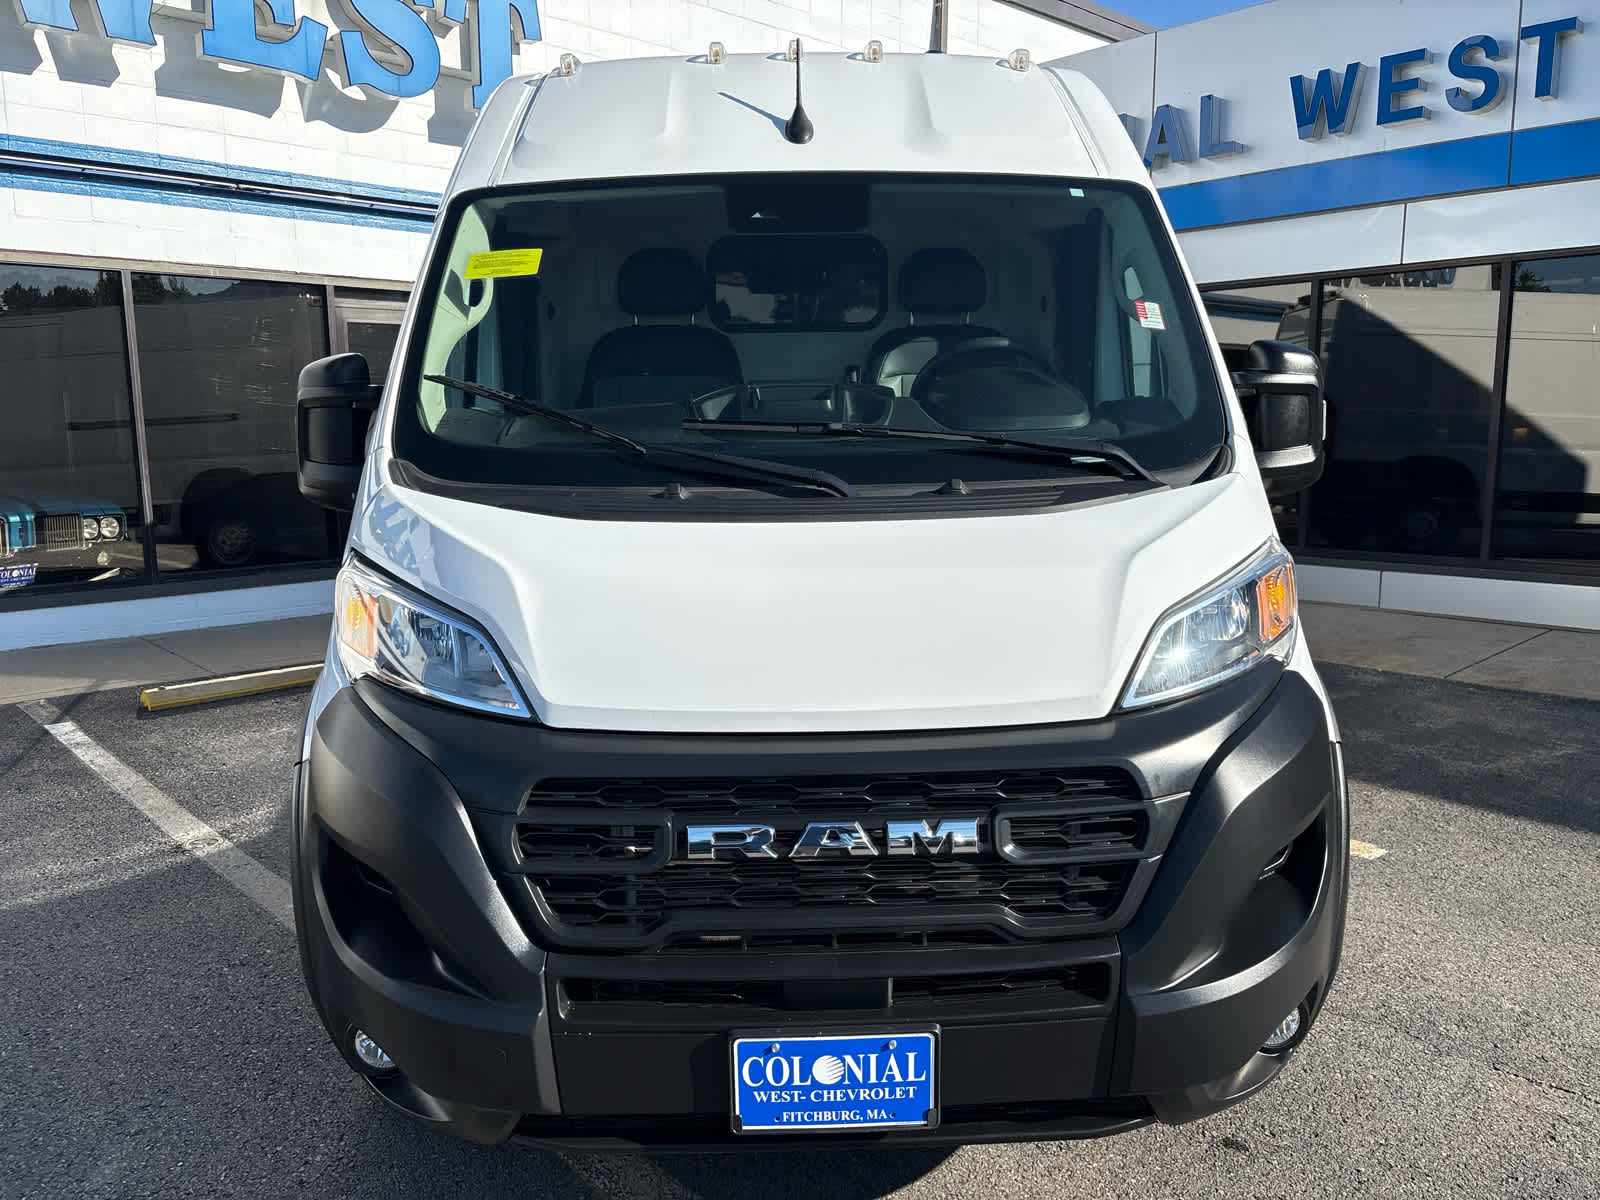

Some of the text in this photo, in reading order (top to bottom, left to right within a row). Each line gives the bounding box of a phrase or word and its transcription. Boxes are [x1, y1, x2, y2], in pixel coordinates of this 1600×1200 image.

[1118, 16, 1583, 168] AL WEST
[687, 818, 979, 859] RAM
[742, 1051, 927, 1087] COLONIAL
[810, 1086, 918, 1102] CHEVROLET
[782, 1109, 888, 1123] FITCHBURG, MA
